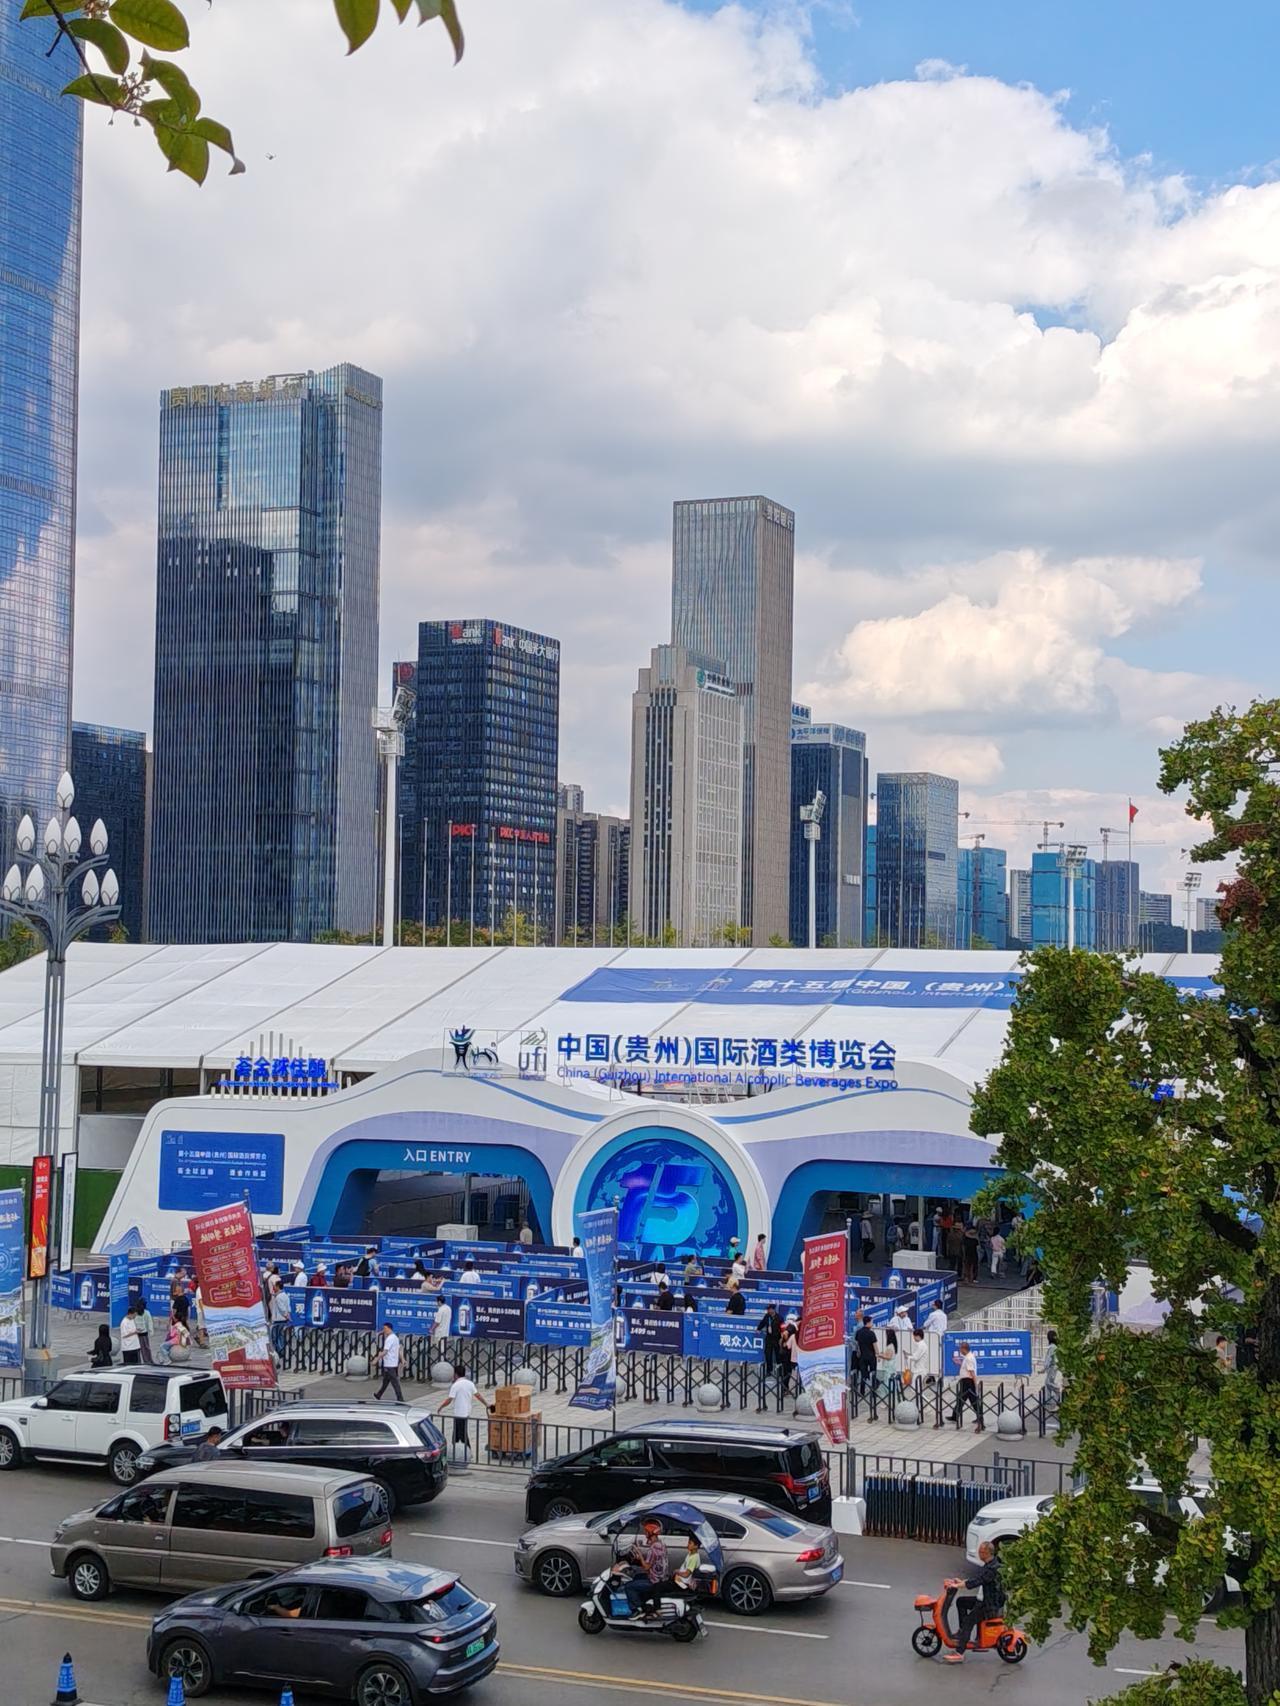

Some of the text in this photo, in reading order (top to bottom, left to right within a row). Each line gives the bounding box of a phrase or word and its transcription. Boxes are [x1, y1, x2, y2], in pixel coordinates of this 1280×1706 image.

[519, 1046, 547, 1071] ufi
[557, 1033, 896, 1072] 中国(贵州)国际酒类博览会
[236, 1056, 326, 1078] 荟全球佳酿
[557, 1067, 898, 1091] China (Guizhou) International Alcoholic Beverages Expo
[403, 1148, 471, 1163] 入口 ENTRY
[618, 1162, 707, 1245] 15
[630, 1327, 646, 1335] 1499
[719, 1335, 764, 1349] 观众入口
